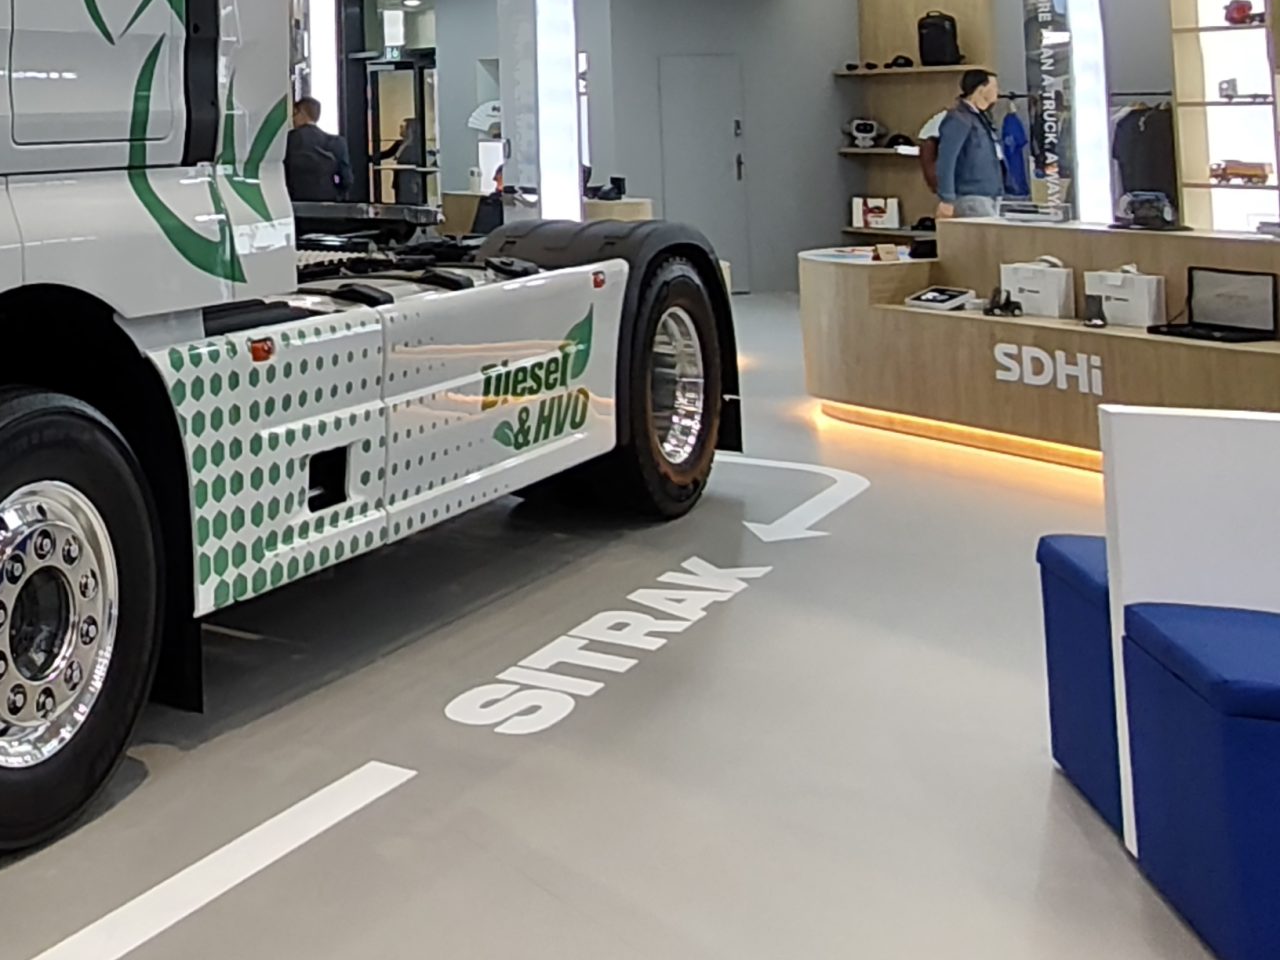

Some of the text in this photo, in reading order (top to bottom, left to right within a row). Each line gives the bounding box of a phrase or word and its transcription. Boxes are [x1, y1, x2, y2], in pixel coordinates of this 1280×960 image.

[1040, 25, 1055, 70] TAN
[1041, 74, 1055, 86] A
[1044, 151, 1059, 163] A
[480, 341, 572, 412] Diesel
[993, 342, 1104, 396] SDHi
[443, 555, 774, 735] SITRAK
